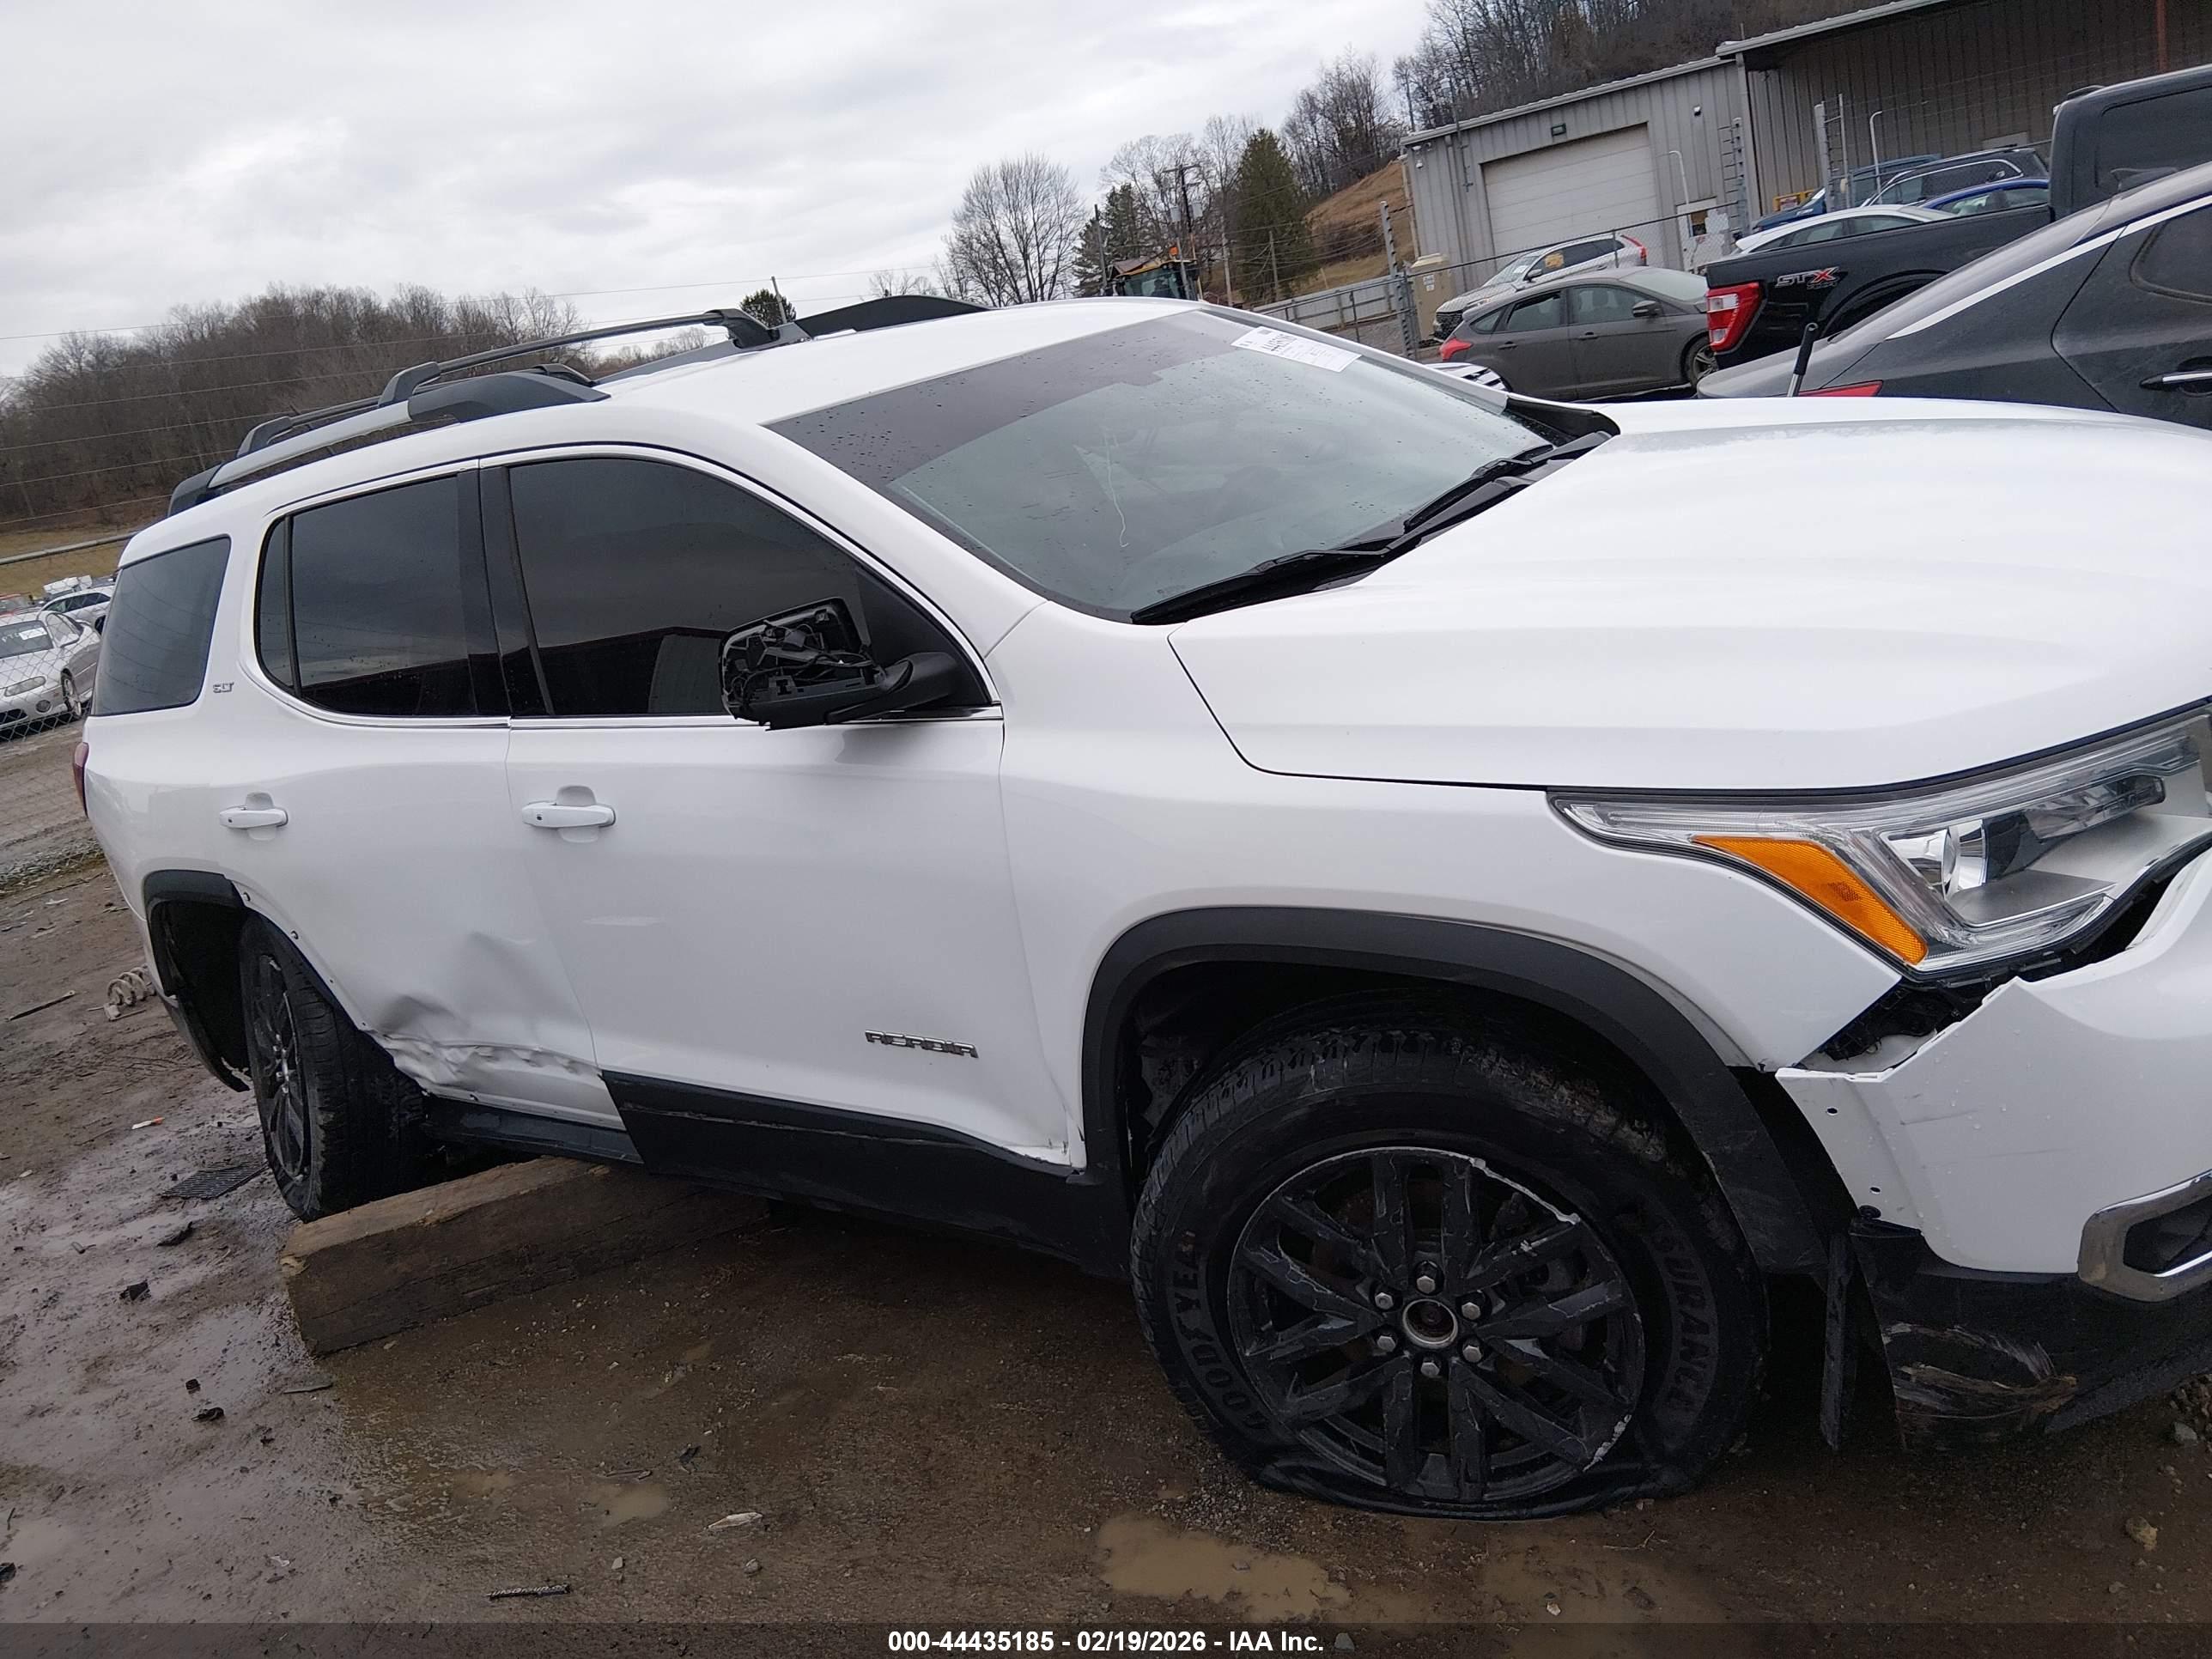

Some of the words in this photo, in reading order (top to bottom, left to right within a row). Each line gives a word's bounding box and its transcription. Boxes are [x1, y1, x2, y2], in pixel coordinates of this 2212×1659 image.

[1775, 265, 1840, 289] STX
[213, 682, 234, 693] SLT
[865, 1030, 980, 1058] ACADIA
[1173, 1228, 1270, 1430] GOODYEA
